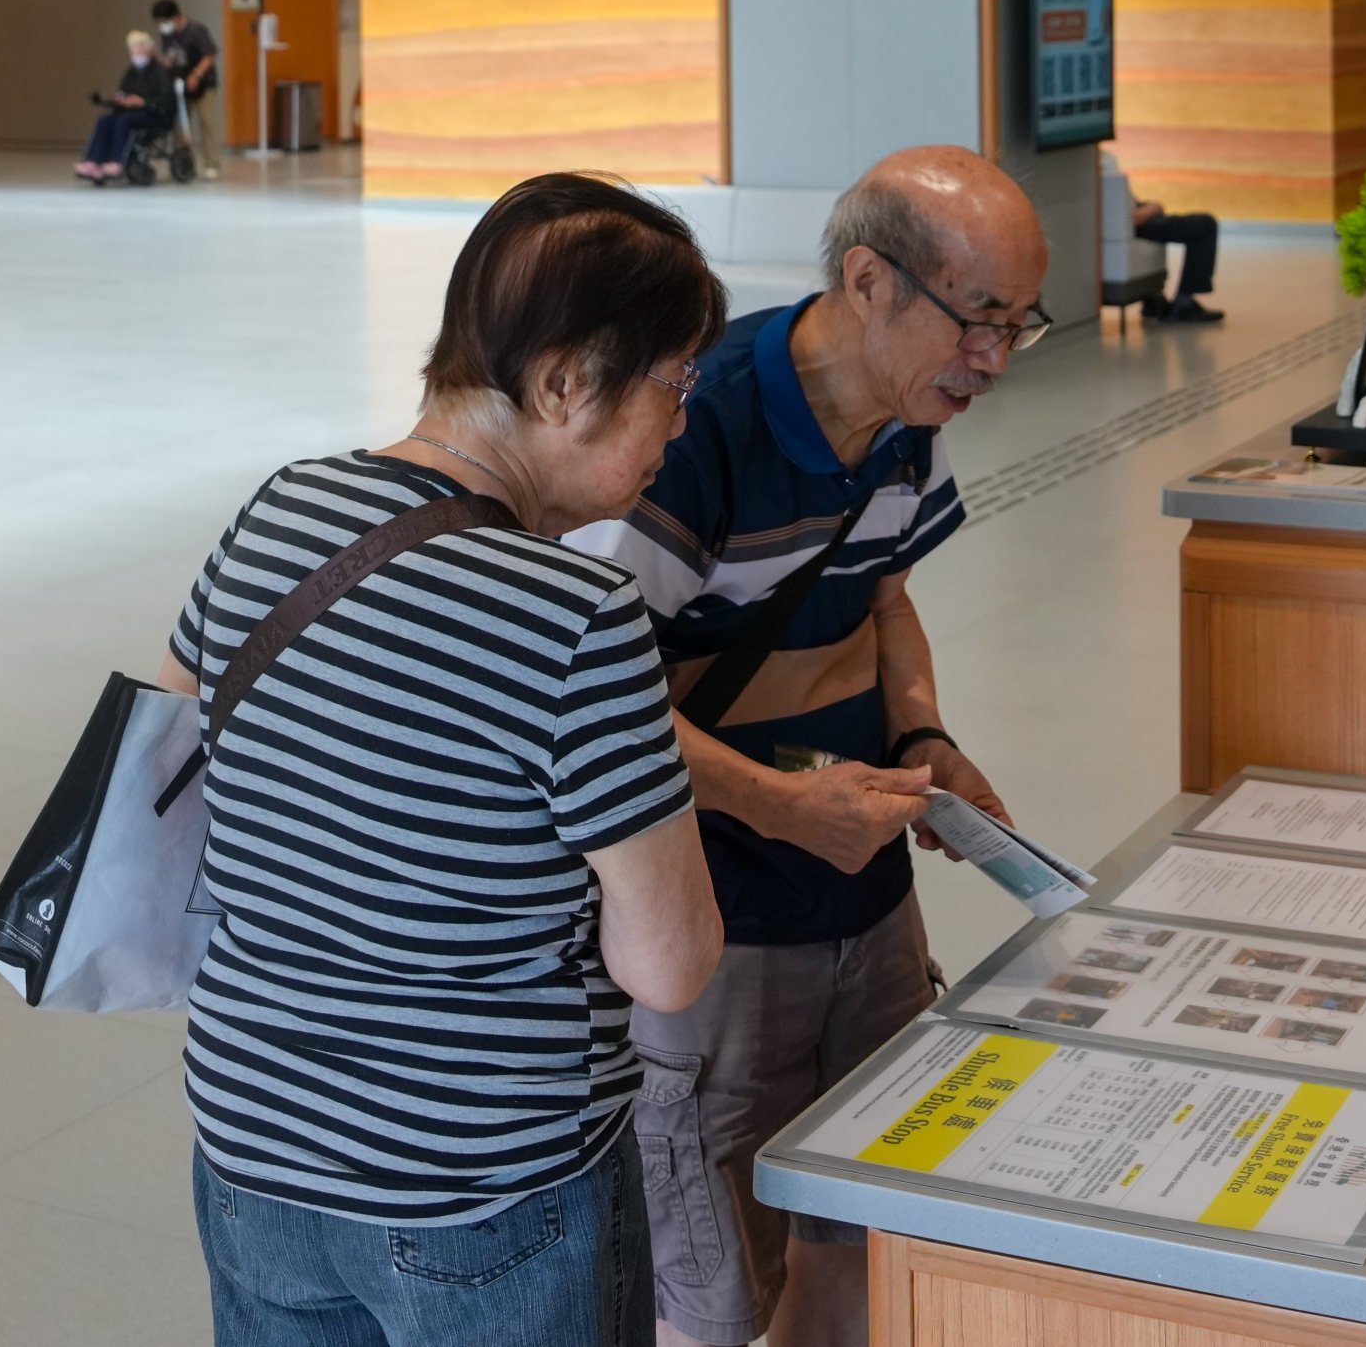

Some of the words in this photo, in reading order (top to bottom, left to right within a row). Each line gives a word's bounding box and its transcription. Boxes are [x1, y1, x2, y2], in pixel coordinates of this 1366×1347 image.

[940, 1050, 1000, 1093] Shuttle
[914, 1091, 956, 1117] Bus
[942, 1076, 1019, 1131] 候車處
[882, 1114, 930, 1145] Stop
[1275, 1113, 1300, 1131] Free
[1250, 1130, 1286, 1161] Shuttle
[1253, 1118, 1325, 1197] 免費接駁服務
[1226, 1160, 1263, 1193] Service
